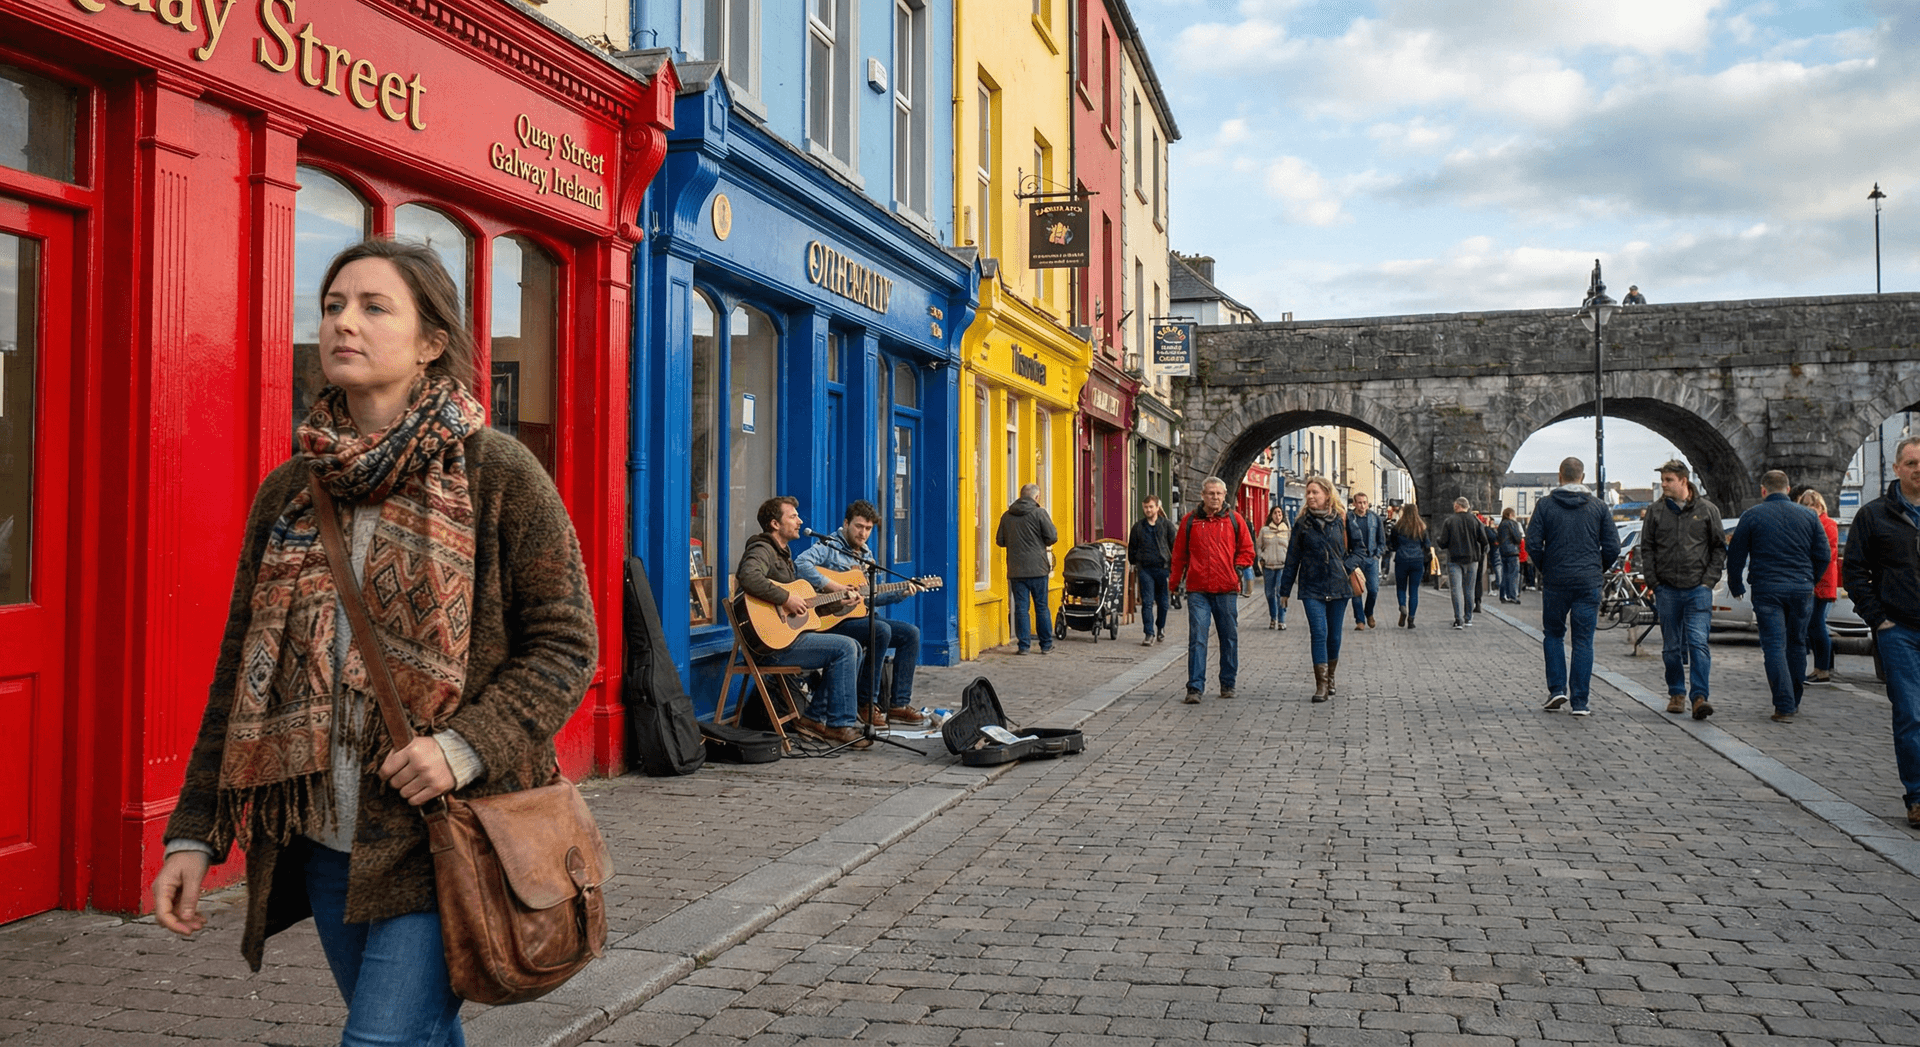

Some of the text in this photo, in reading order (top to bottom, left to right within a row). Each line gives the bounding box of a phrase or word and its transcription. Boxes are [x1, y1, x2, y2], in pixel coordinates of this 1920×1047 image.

[258, 0, 427, 131] Street
[491, 142, 603, 210] Galway, Ireland
[516, 113, 605, 175] Quay Street
